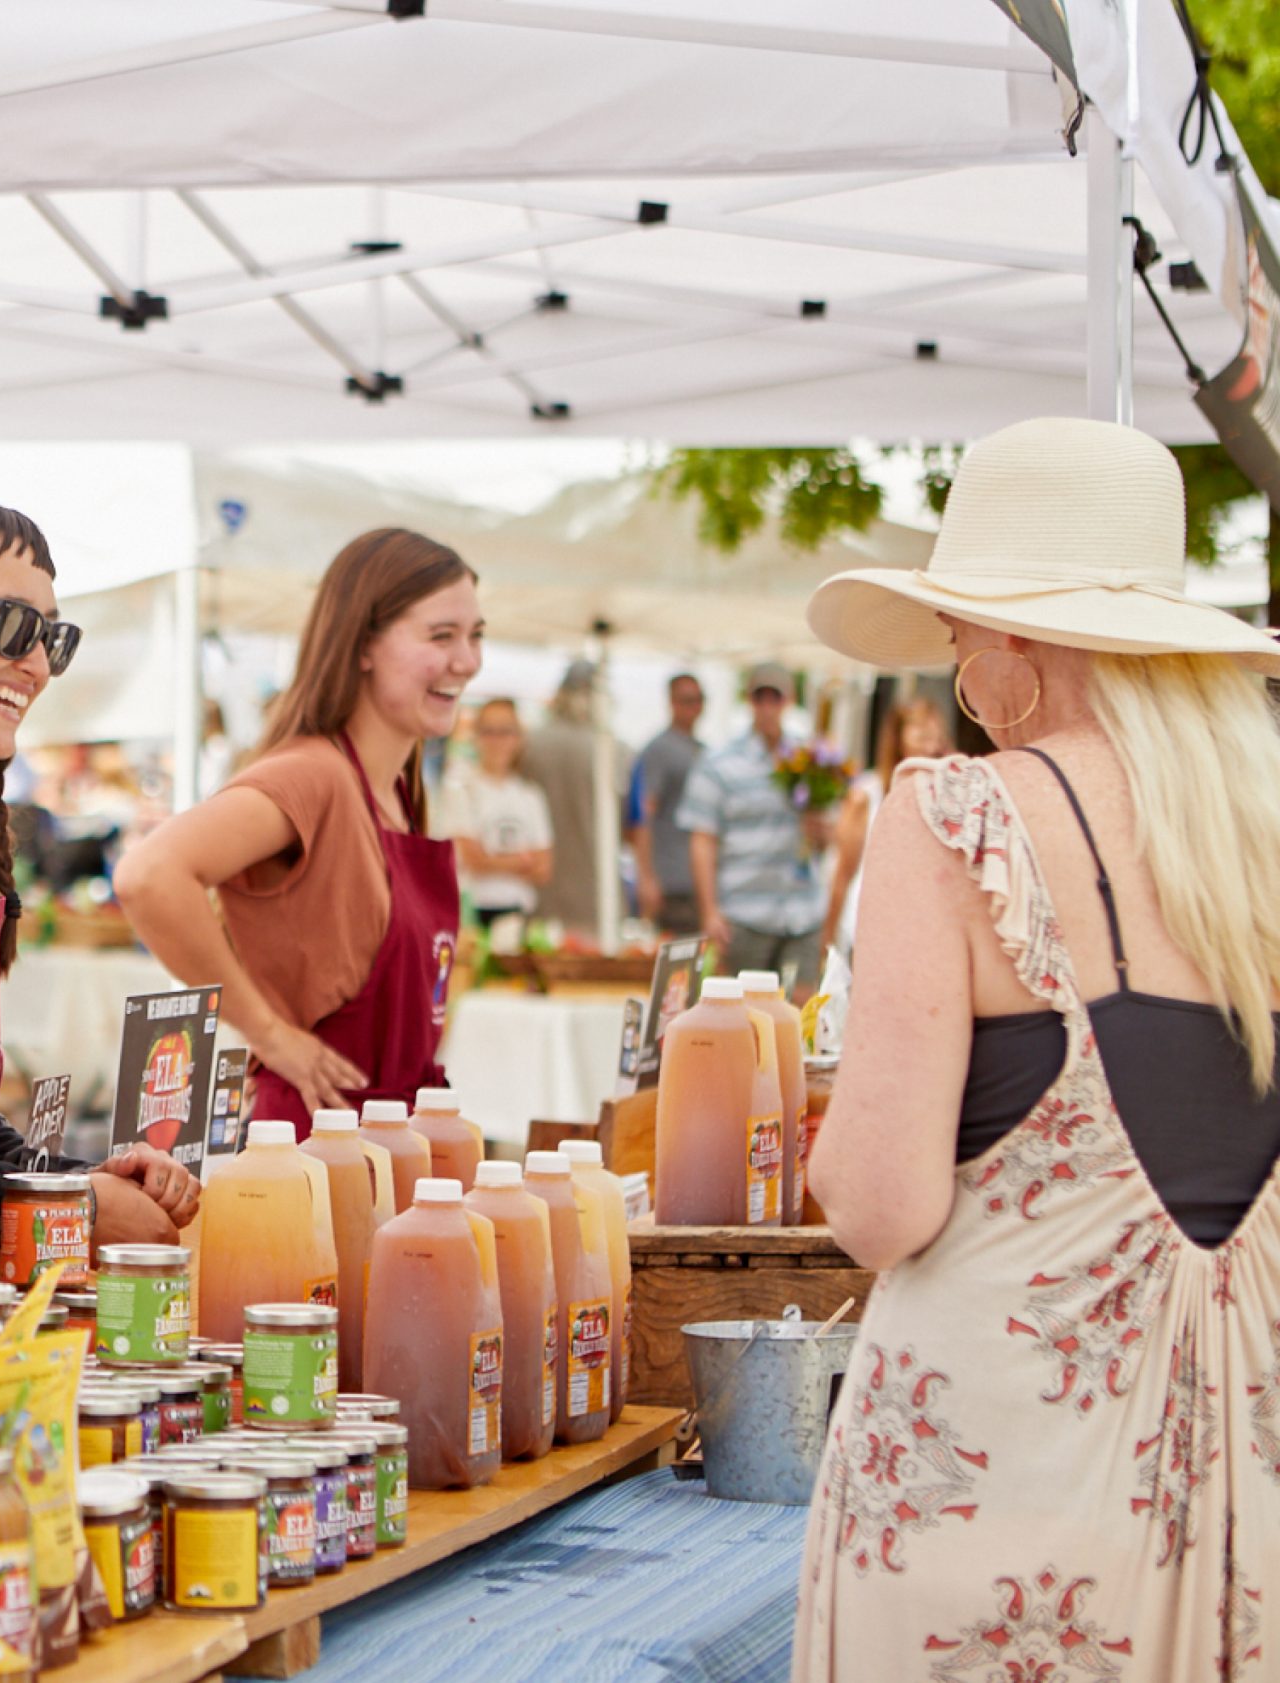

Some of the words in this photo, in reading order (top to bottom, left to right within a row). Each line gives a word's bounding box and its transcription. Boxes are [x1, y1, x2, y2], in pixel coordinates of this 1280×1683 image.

[153, 1052, 184, 1093] ELA
[32, 1076, 70, 1118] APPLE
[51, 1227, 83, 1244] ELA
[582, 1319, 604, 1340] ELA
